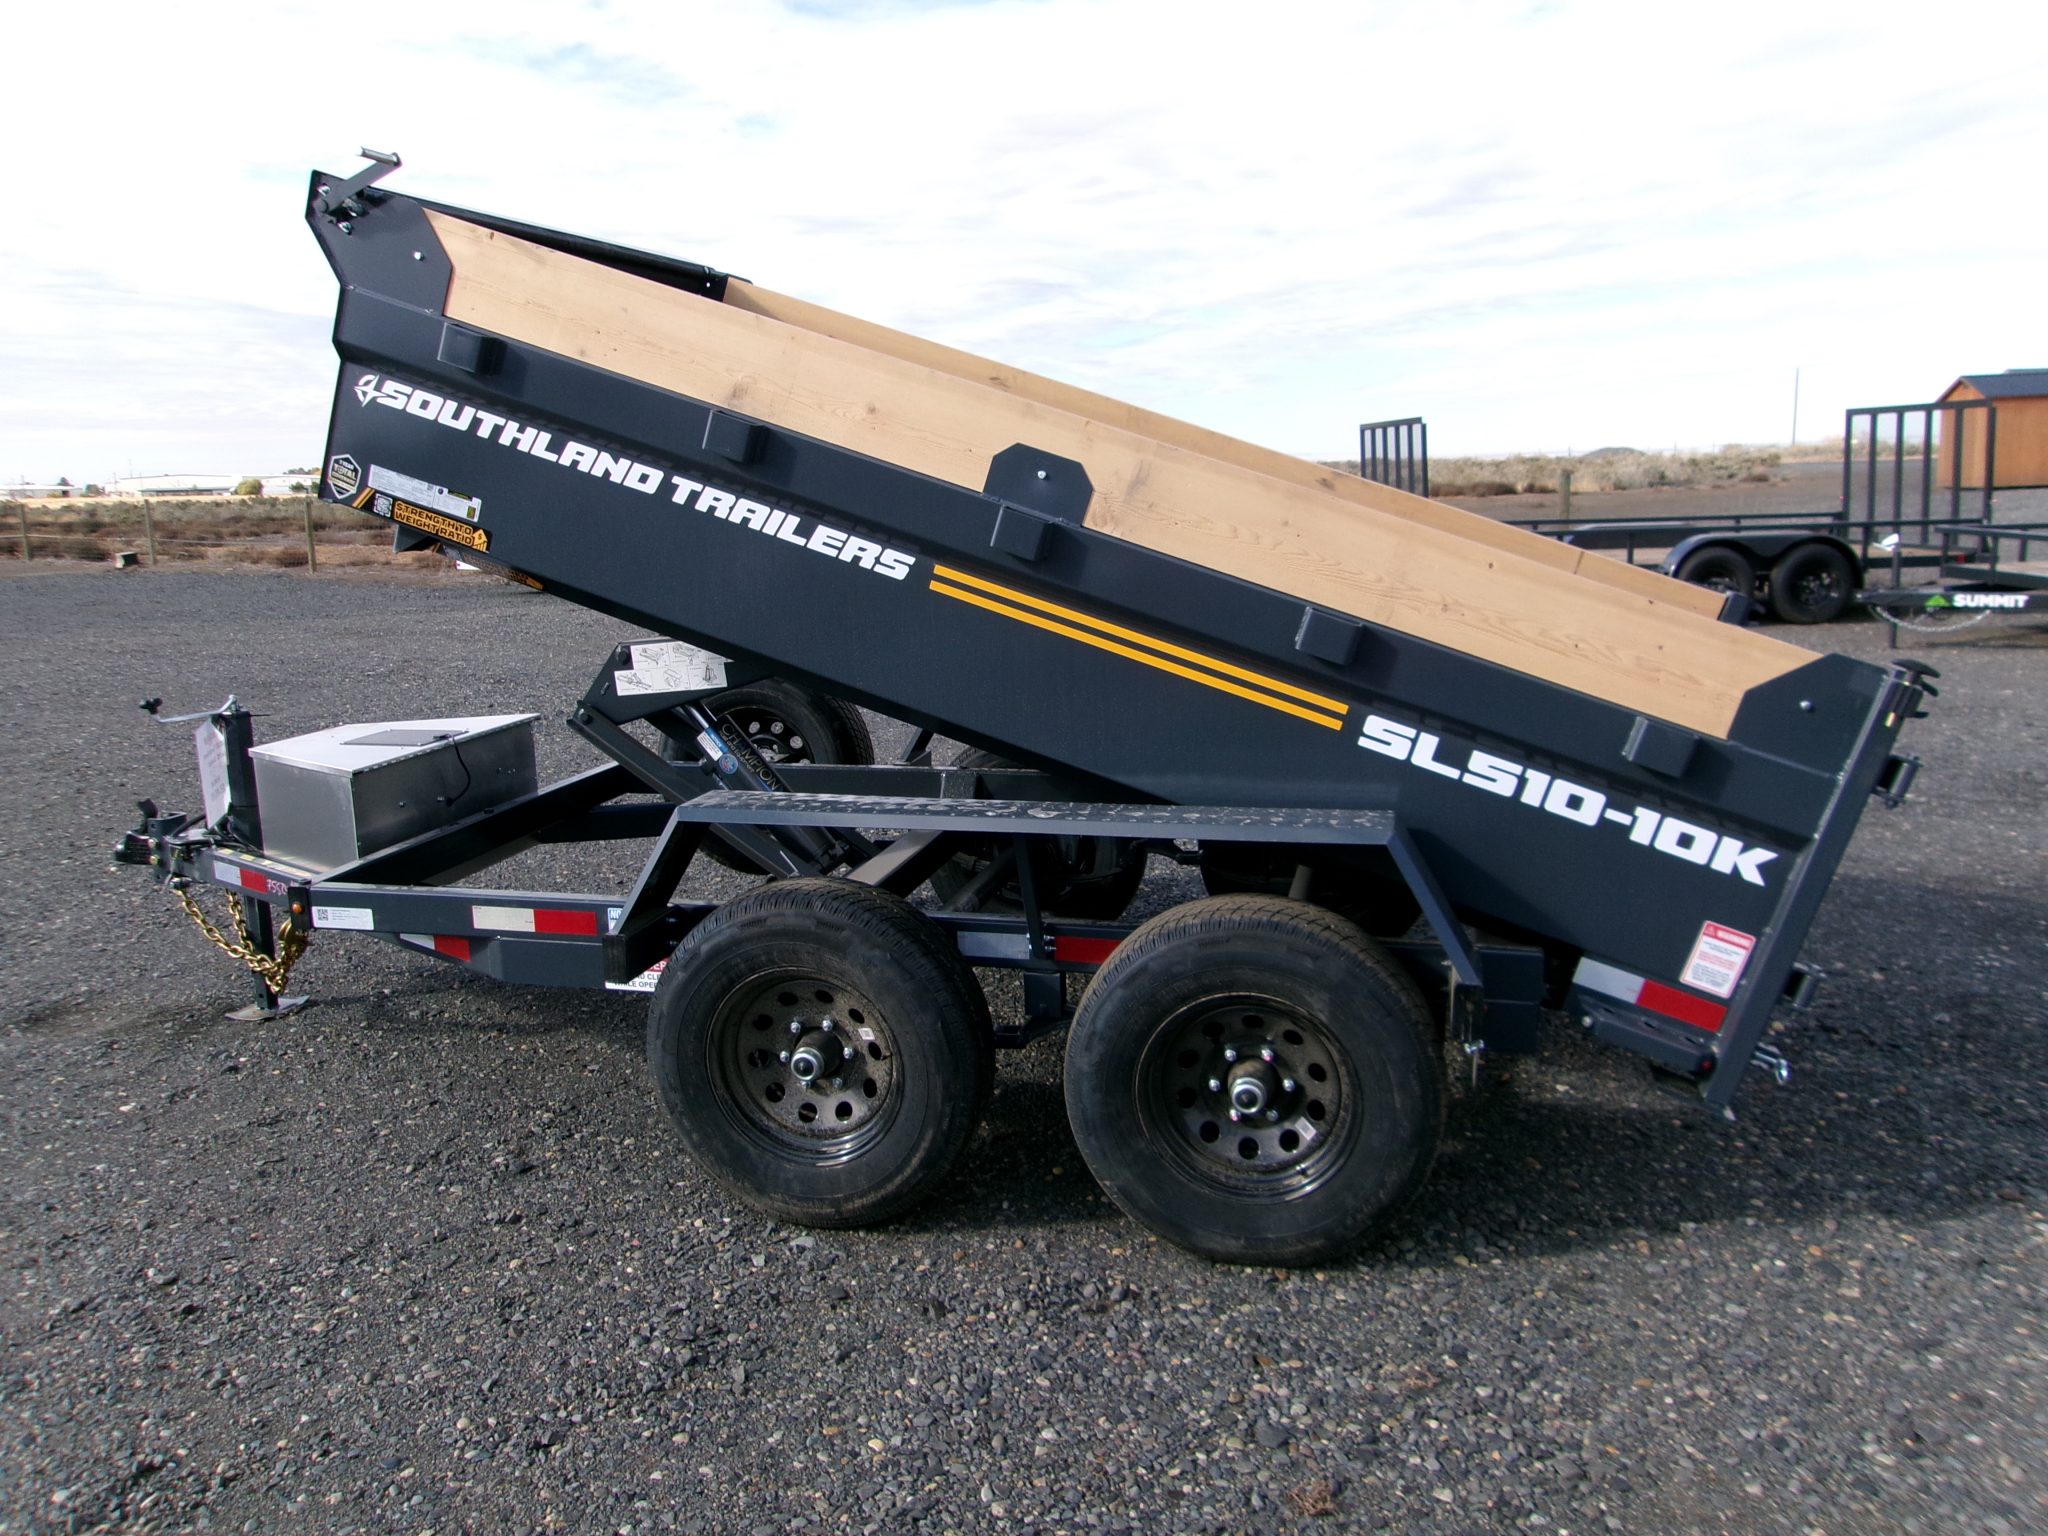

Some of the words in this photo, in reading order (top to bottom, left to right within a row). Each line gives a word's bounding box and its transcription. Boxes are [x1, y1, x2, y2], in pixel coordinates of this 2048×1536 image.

[333, 463, 356, 480] TOTAL
[376, 379, 664, 495] SOUTHLAND
[671, 475, 916, 581] TRAILERS
[395, 502, 456, 530] STRENGTH
[457, 524, 472, 536] TO
[395, 511, 439, 534] WEIGHT
[439, 527, 472, 545] RATIO
[1953, 593, 2030, 608] SUMMIT
